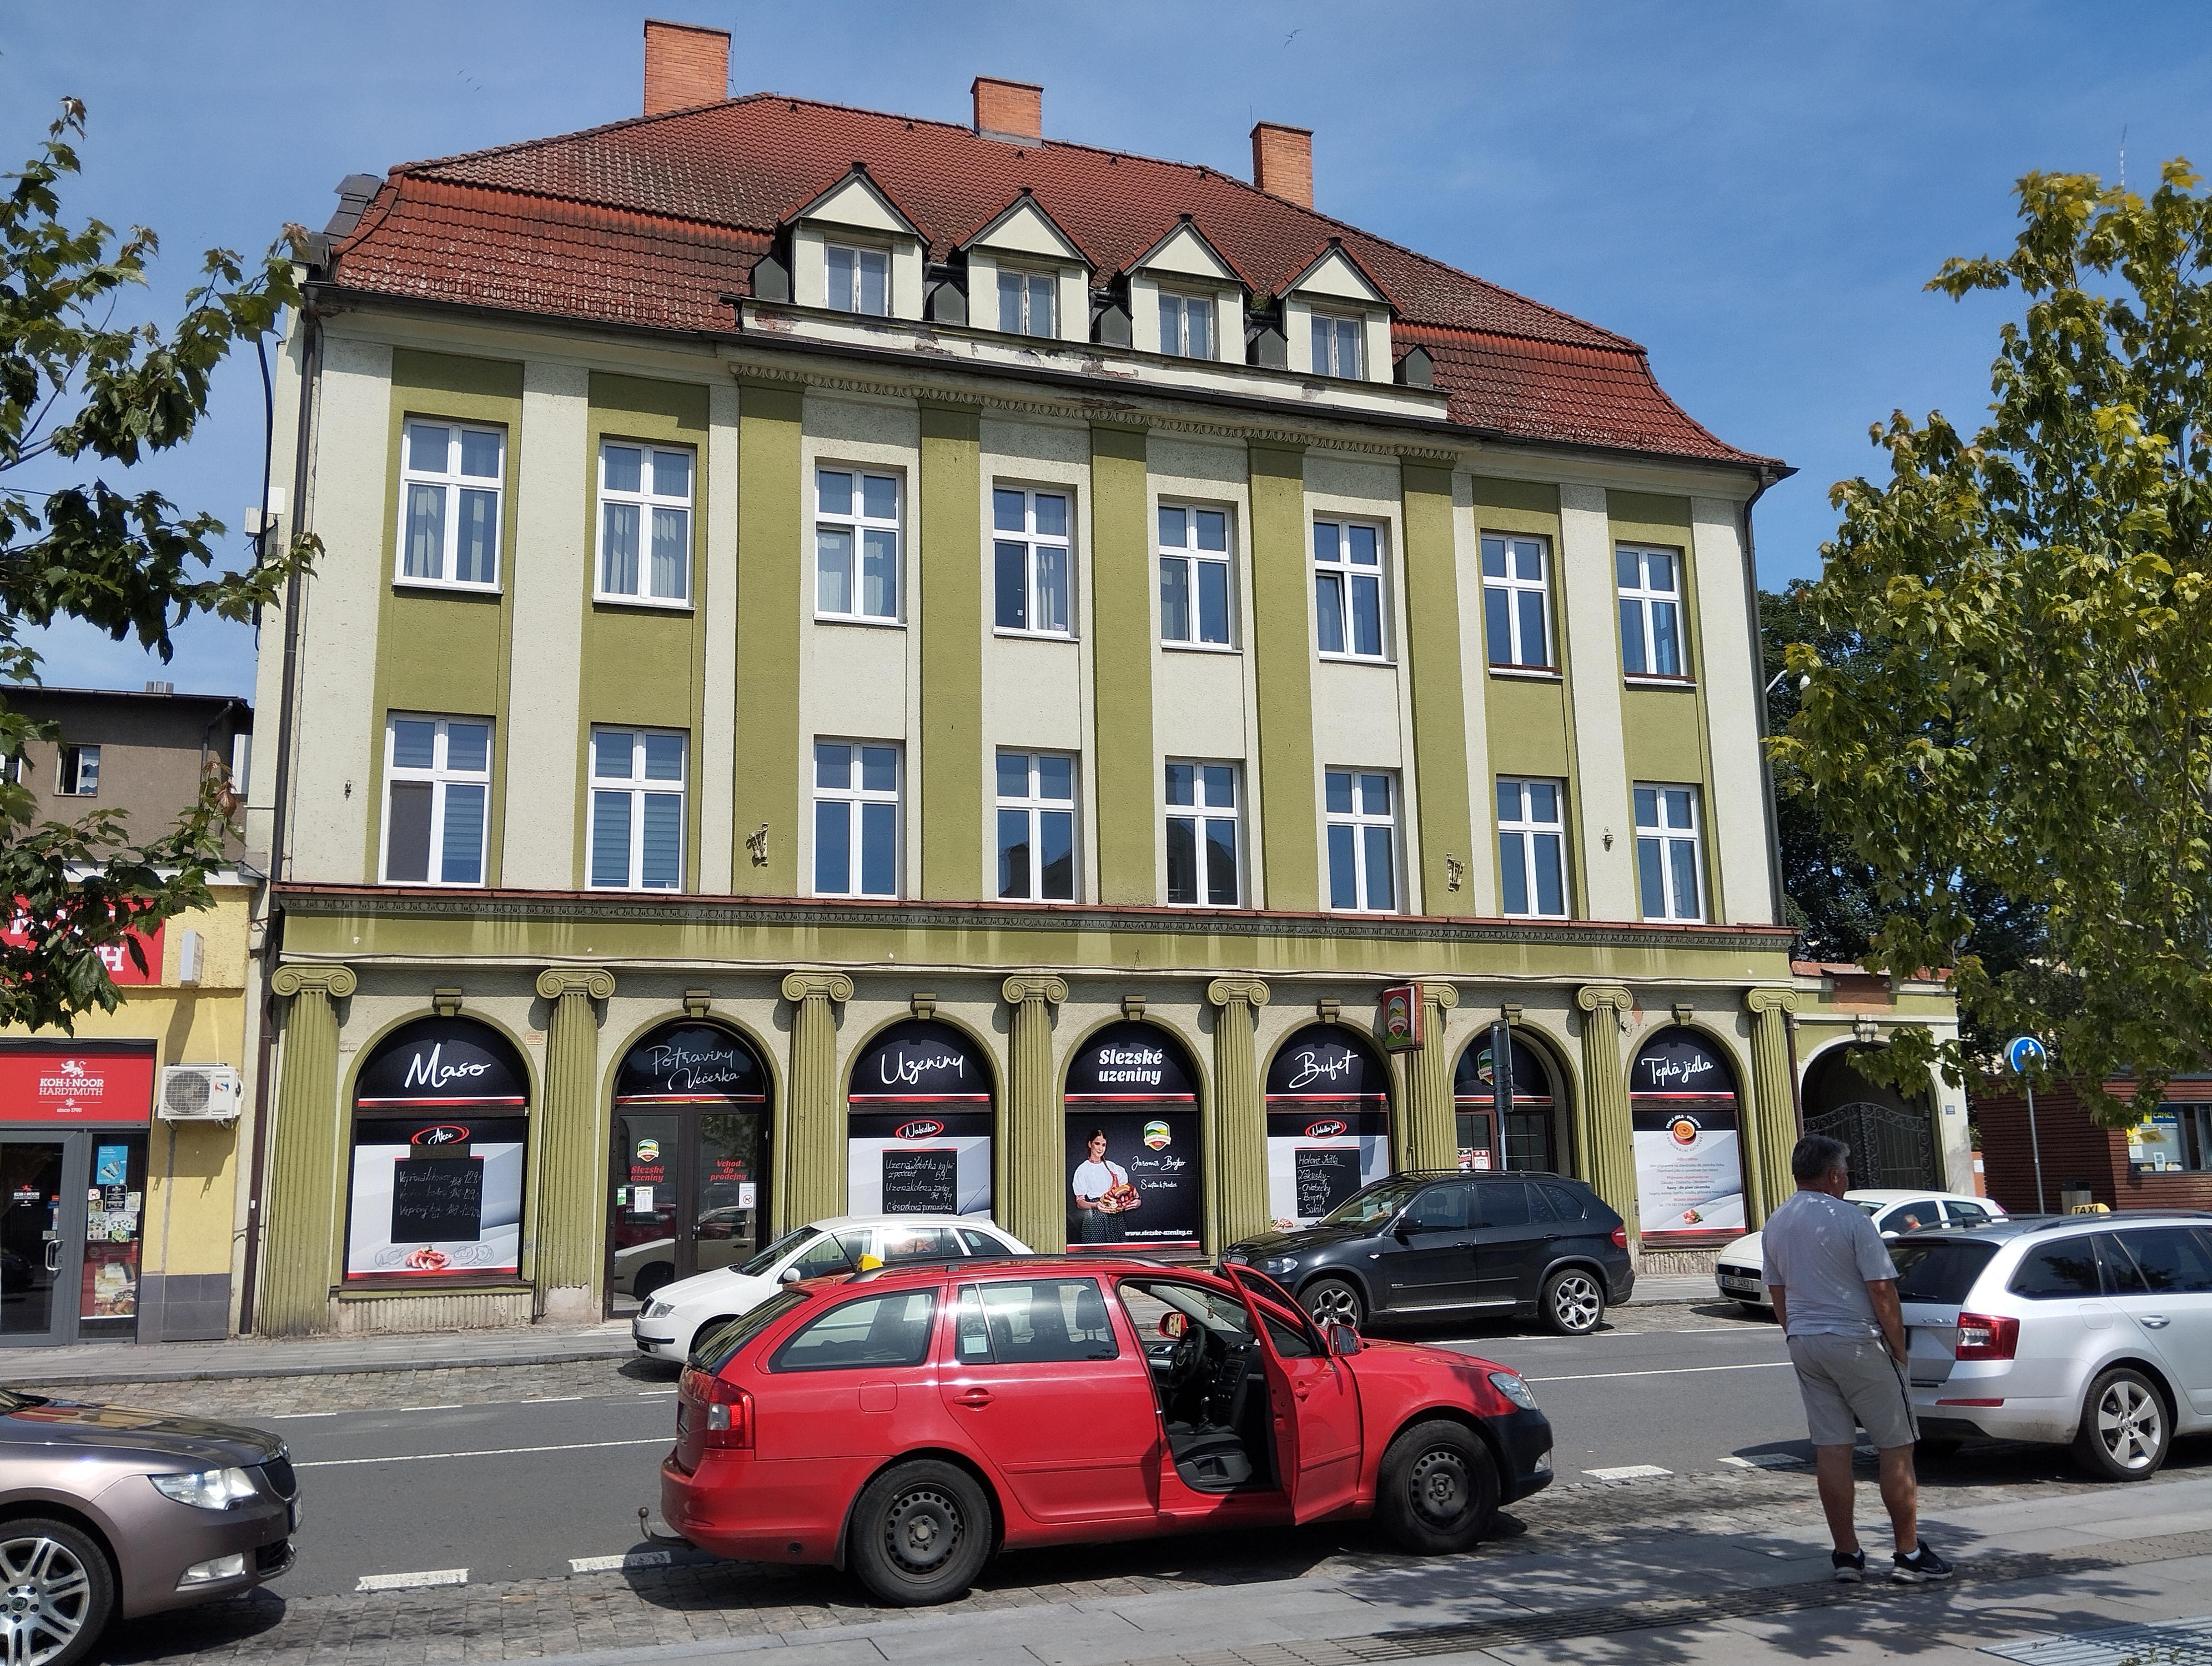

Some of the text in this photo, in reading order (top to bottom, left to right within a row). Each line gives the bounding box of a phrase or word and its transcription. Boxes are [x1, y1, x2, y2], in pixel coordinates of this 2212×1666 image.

[404, 1043, 492, 1088] Maso
[645, 1045, 733, 1075] Potraviny
[1099, 1049, 1163, 1065] Slezské
[881, 1052, 964, 1085] Uzeniny
[1099, 1068, 1162, 1085] uzeniny
[1289, 1050, 1358, 1088] Bufet
[1641, 1055, 1713, 1086] Teplá jídla
[39, 1078, 104, 1087] KOH-I-NOOR
[668, 1066, 740, 1090] Večerka
[38, 1087, 103, 1096] HARDTMUTH
[428, 1128, 454, 1145] Akce
[906, 1122, 937, 1138] Nabídka
[1160, 1155, 1186, 1171] Bojko
[2074, 1205, 2098, 1215] TAXI
